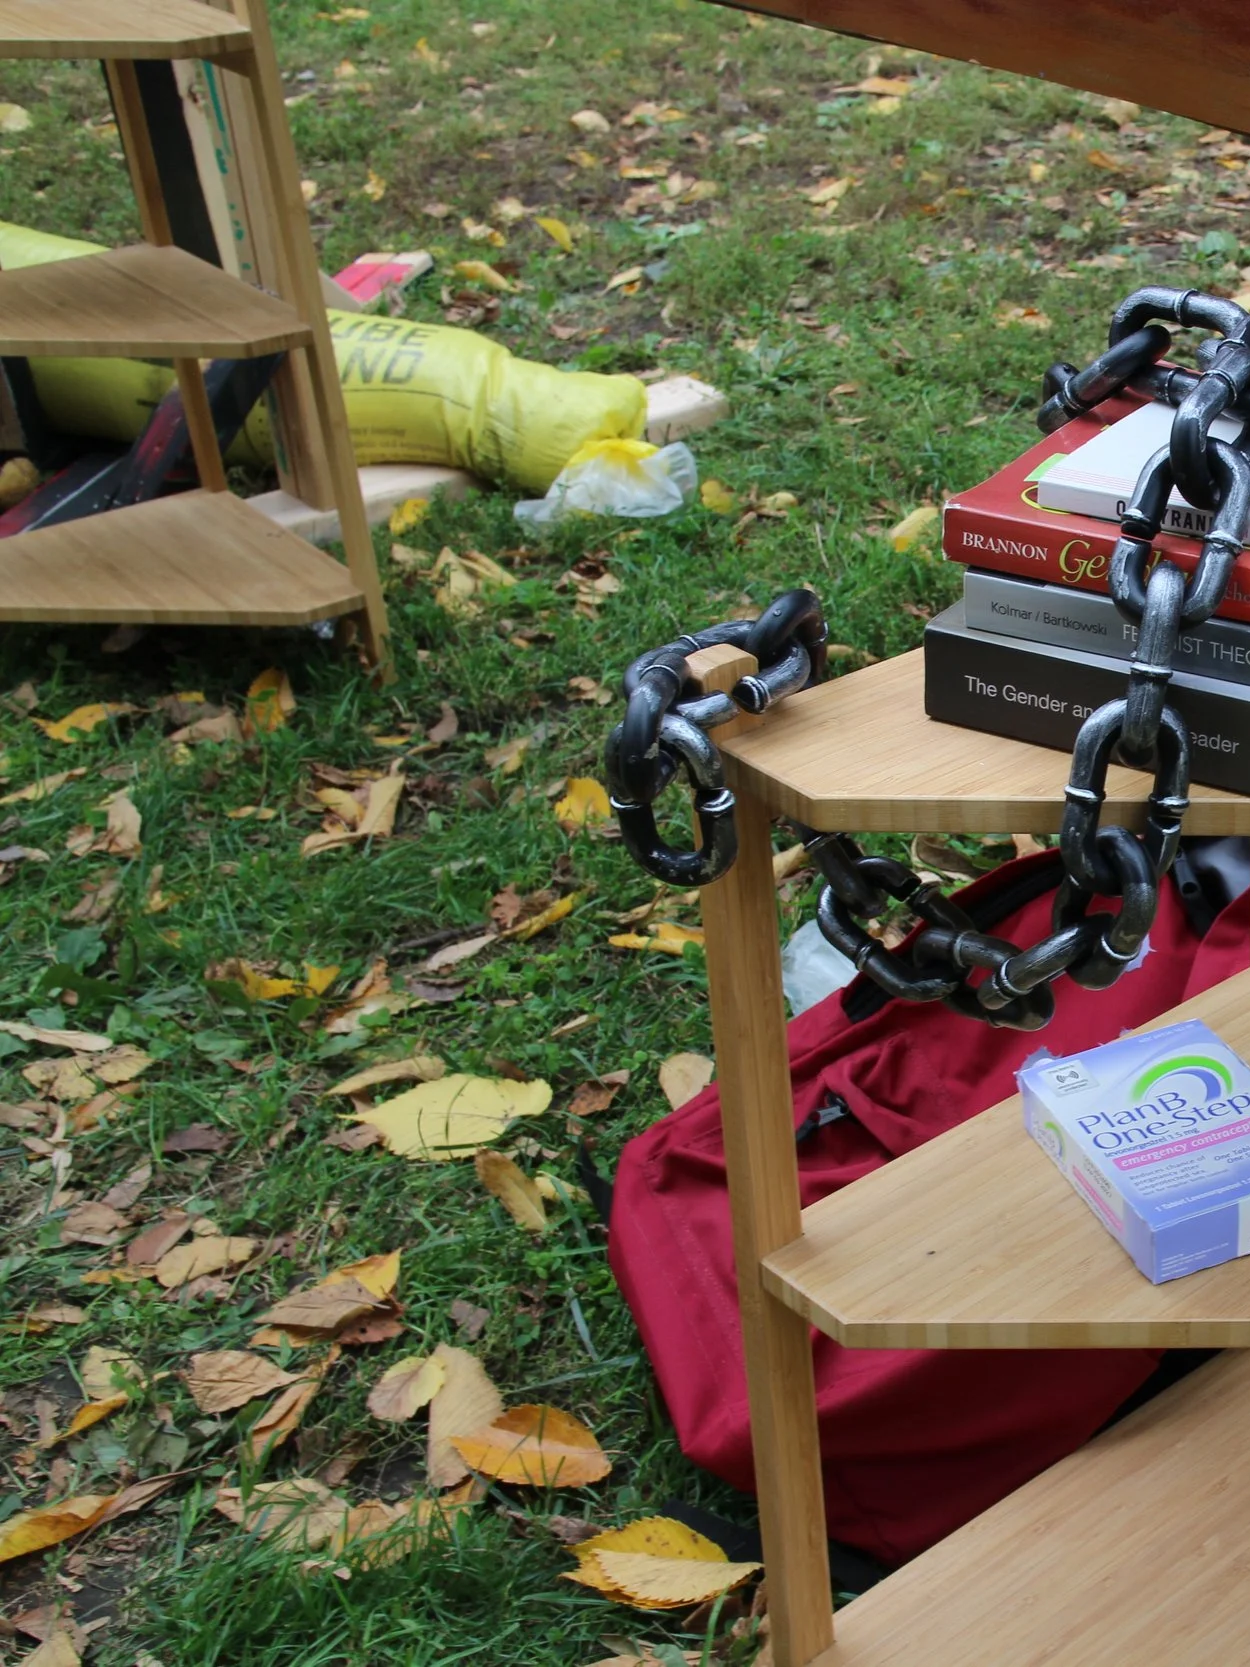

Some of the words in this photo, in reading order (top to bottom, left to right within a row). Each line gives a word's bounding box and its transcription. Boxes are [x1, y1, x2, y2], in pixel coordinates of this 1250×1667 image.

[962, 532, 1048, 561] BRANNON
[991, 601, 1032, 622] Kolmar
[1043, 611, 1107, 637] Bartkowski
[965, 675, 998, 697] The
[1002, 684, 1068, 714] Gender
[1072, 703, 1094, 720] an
[1190, 731, 1240, 755] eader
[1182, 1127, 1200, 1138] mg
[1120, 1142, 1188, 1168] emergency
